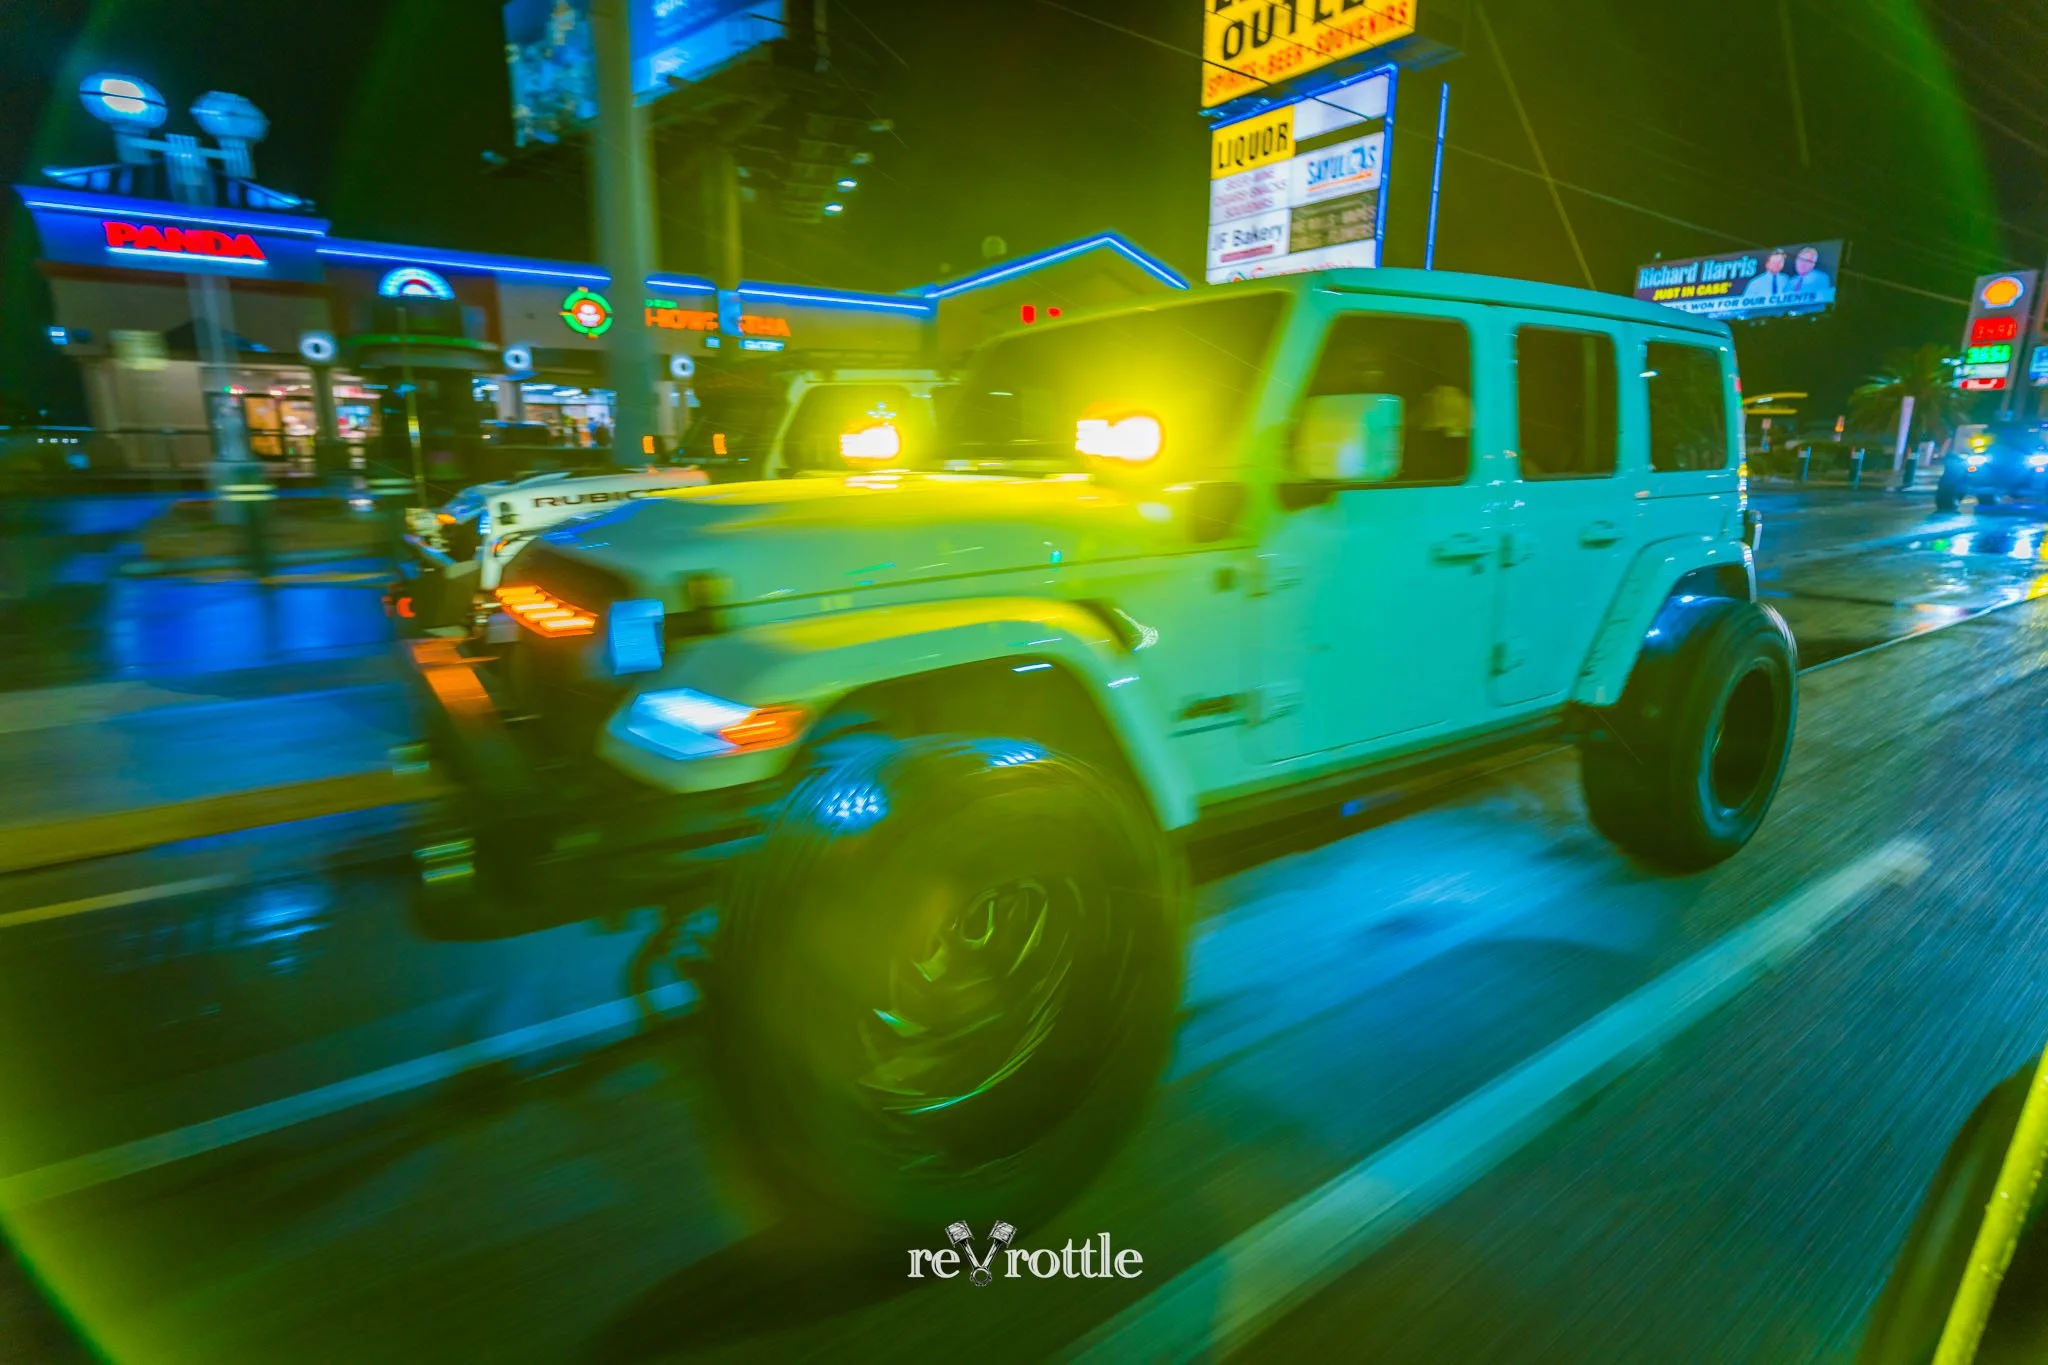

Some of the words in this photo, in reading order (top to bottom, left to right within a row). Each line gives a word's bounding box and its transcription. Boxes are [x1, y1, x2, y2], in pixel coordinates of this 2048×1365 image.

[1216, 122, 1288, 170] LIQUOR
[102, 221, 267, 260] PANDA
[1233, 223, 1282, 247] Bakery
[1638, 261, 1699, 288] Richard
[1702, 256, 1758, 280] Harris
[1652, 286, 1678, 301] JUST
[1680, 285, 1695, 298] IN
[1691, 301, 1714, 311] WON
[1718, 299, 1740, 309] FOR
[1742, 297, 1768, 307] OUR
[1769, 291, 1818, 305] CLIENTS
